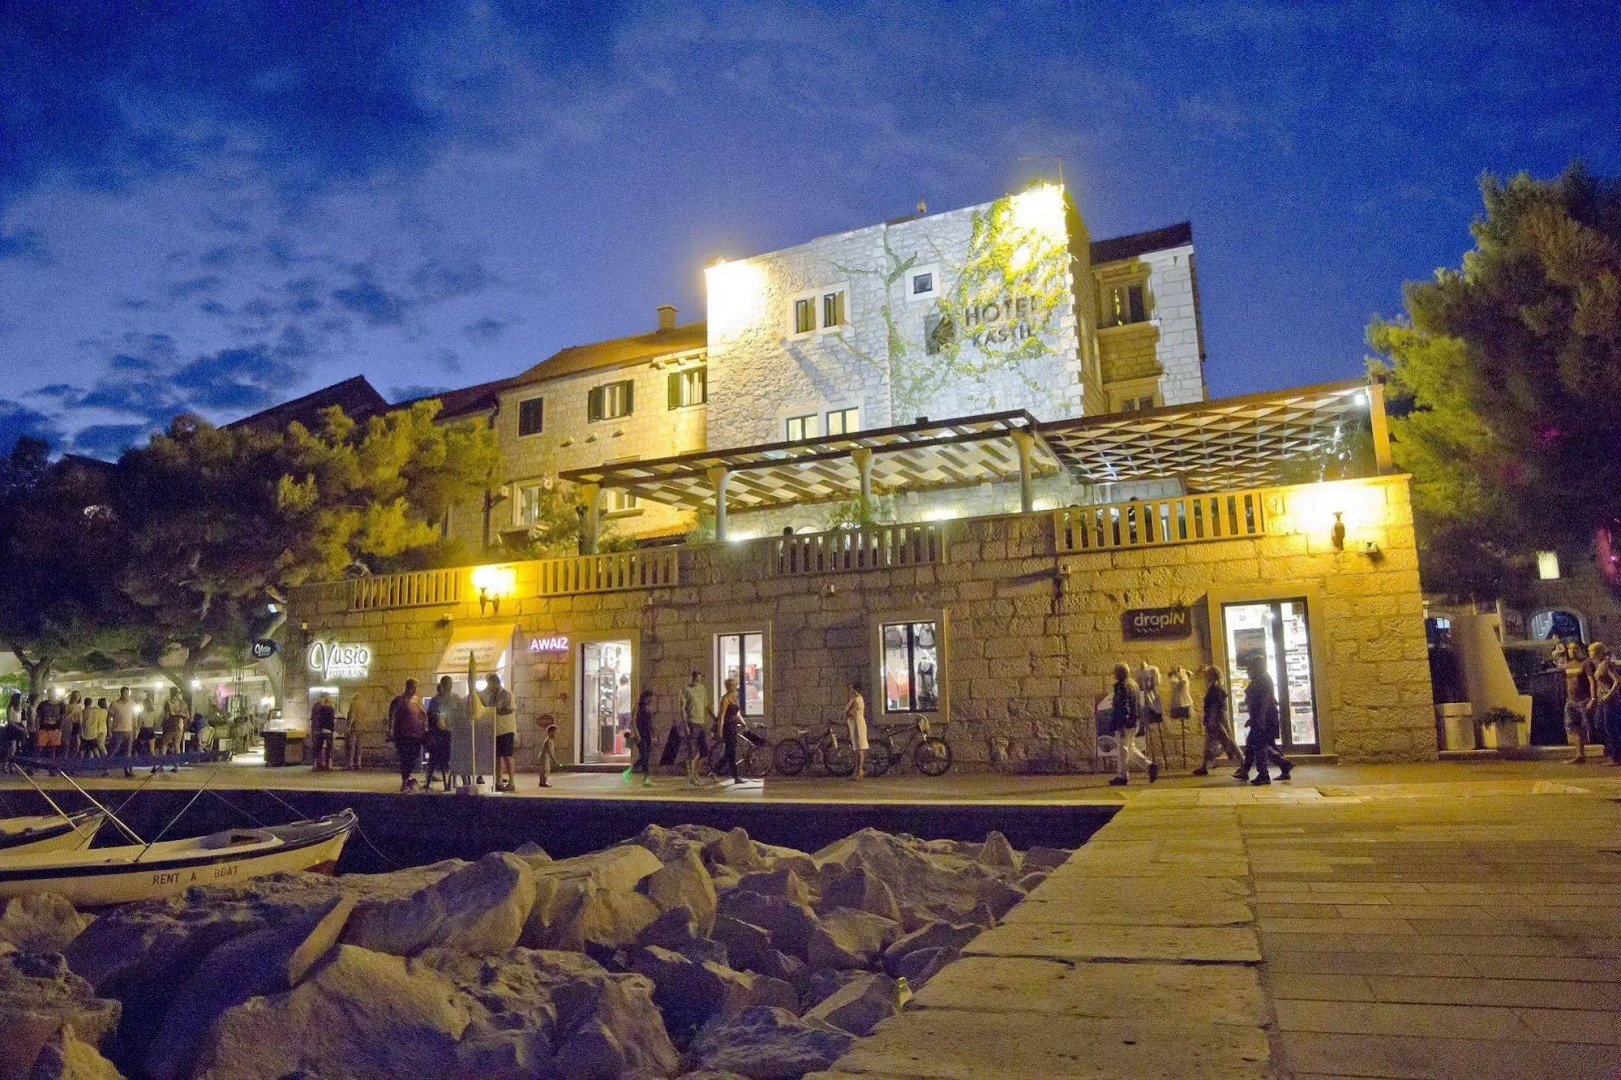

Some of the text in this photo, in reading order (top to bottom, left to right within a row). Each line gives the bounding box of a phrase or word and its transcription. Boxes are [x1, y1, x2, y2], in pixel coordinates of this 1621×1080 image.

[530, 637, 569, 651] AWAIZ
[309, 642, 368, 680] Vusio
[152, 865, 239, 885] RENT A BOAT
